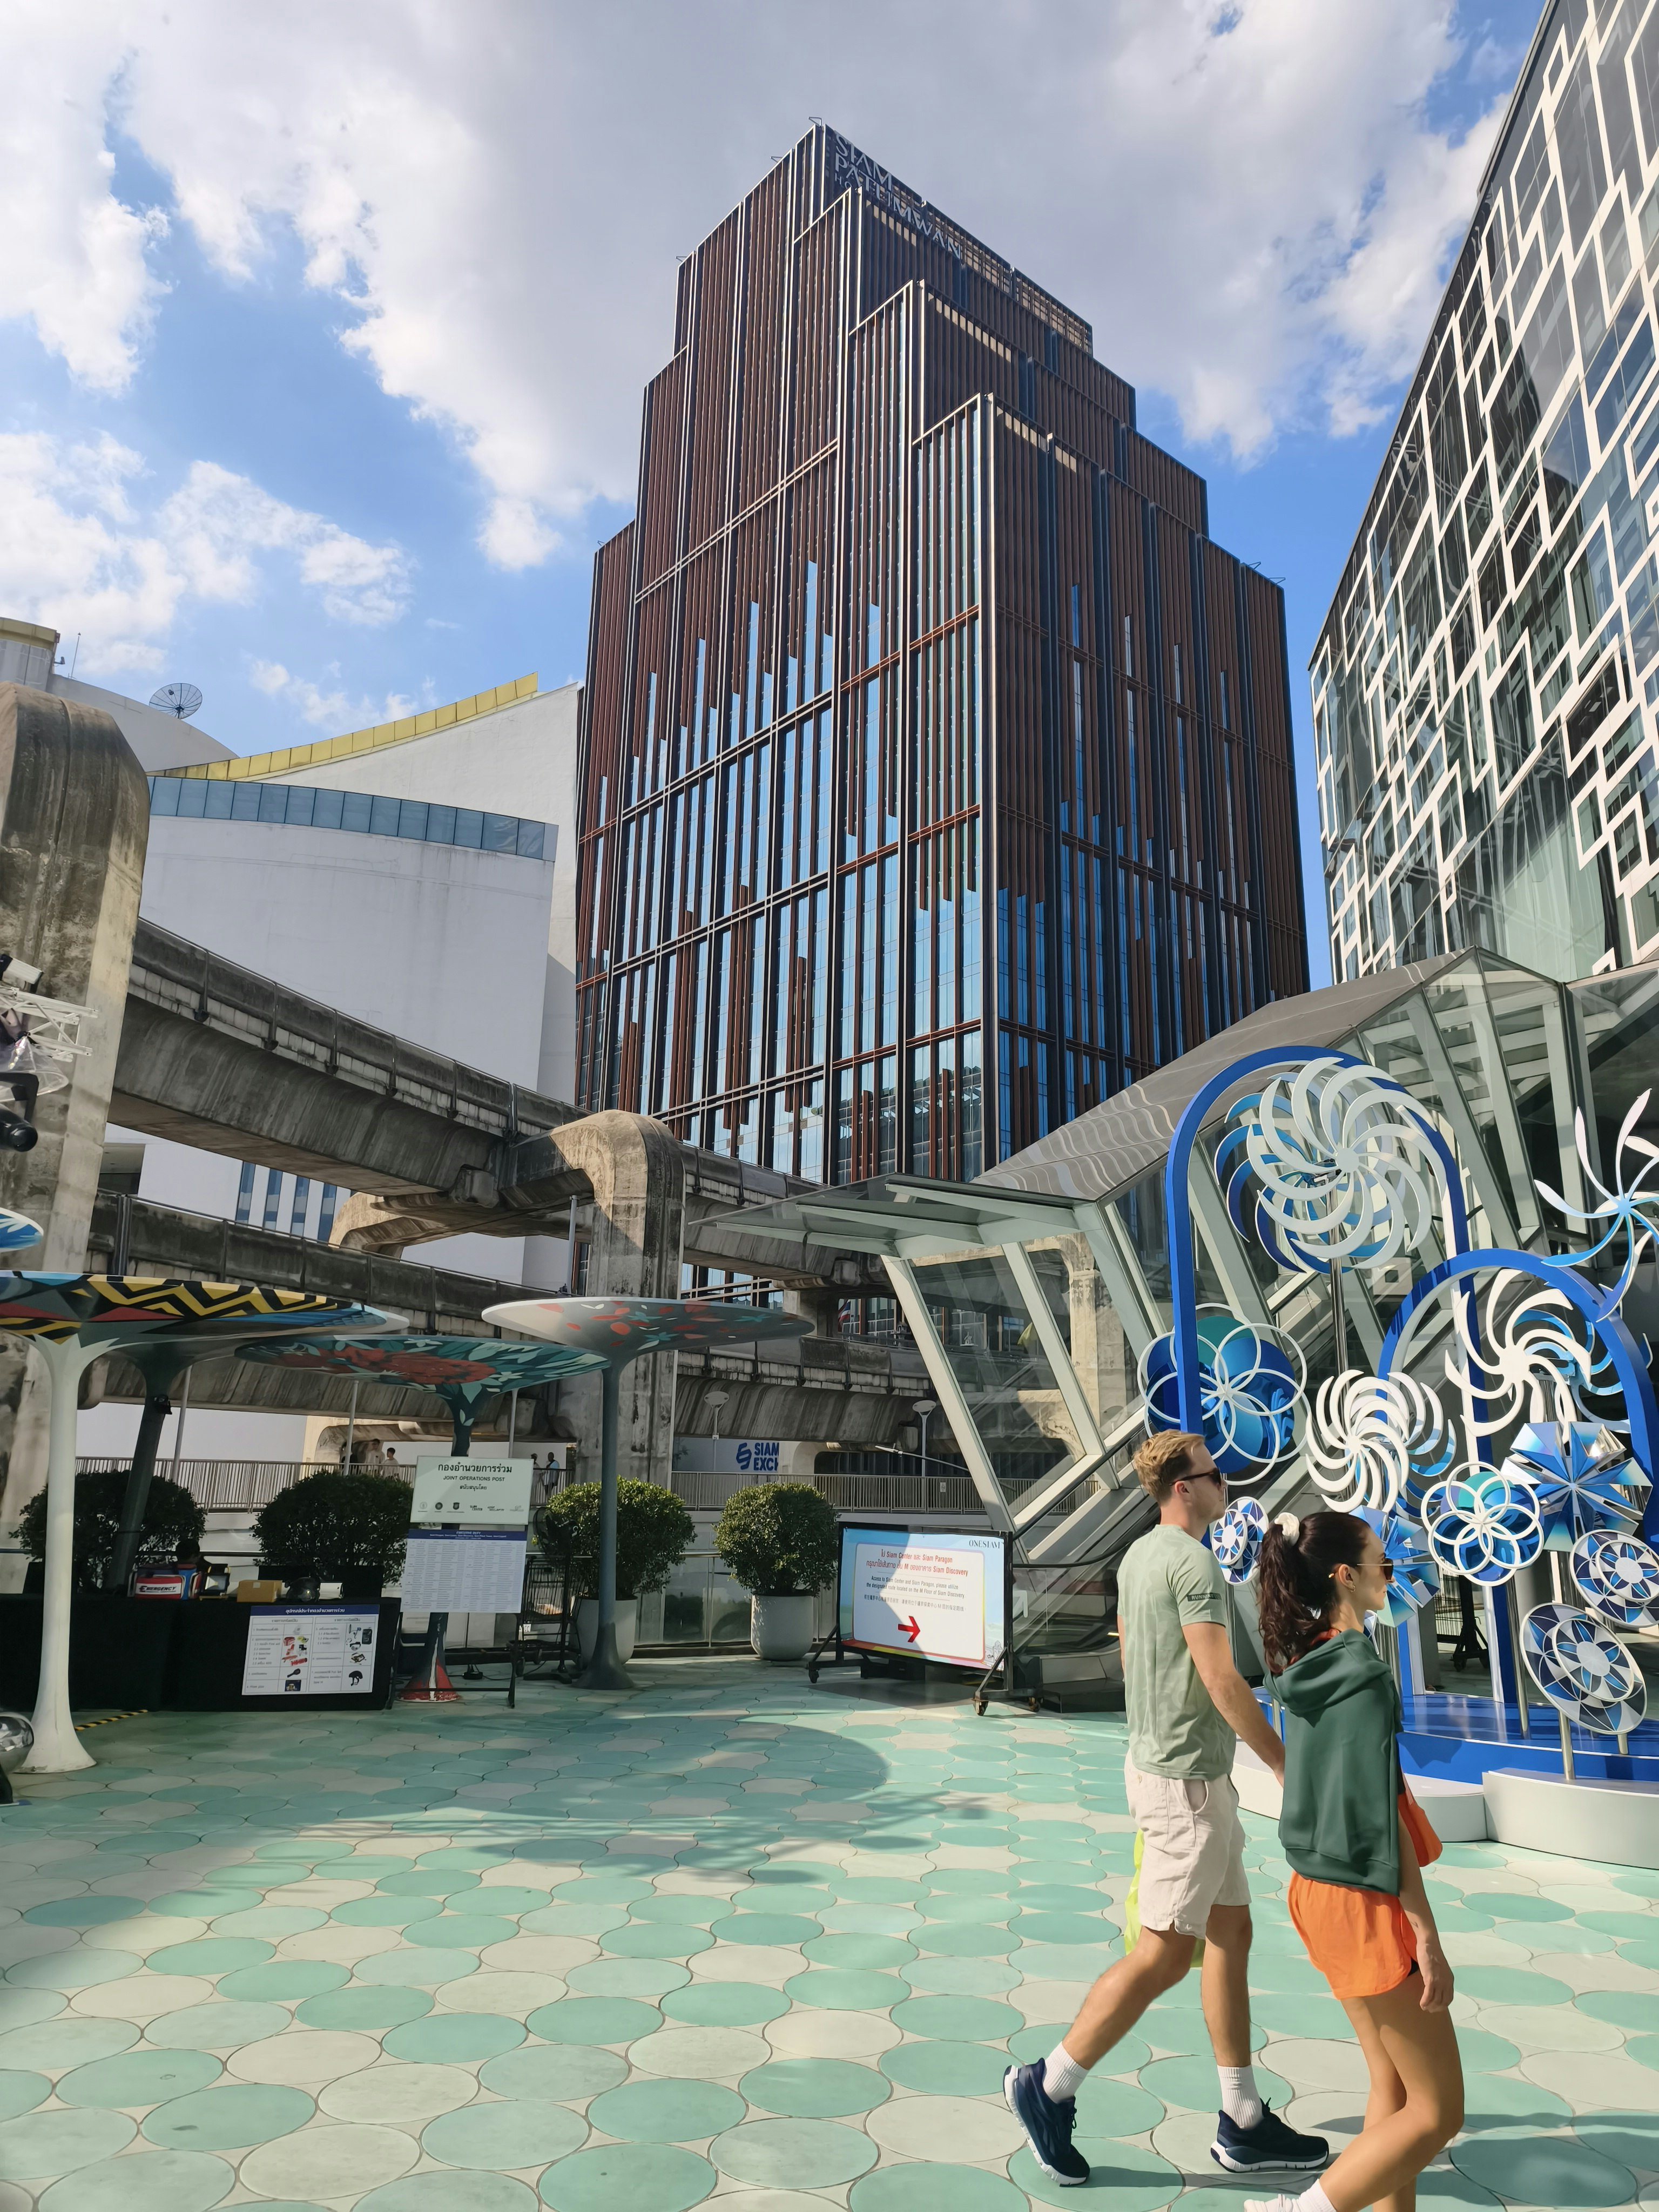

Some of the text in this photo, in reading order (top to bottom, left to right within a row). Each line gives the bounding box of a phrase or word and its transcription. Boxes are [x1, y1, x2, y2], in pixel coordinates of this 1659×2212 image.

[835, 133, 892, 192] SIAM
[835, 152, 961, 260] PATUMWAN
[754, 1442, 779, 1456] SIAM
[438, 1461, 512, 1473] กองอำนวยการร่วม
[968, 1540, 1001, 1549] ONESIAM
[881, 1549, 885, 1557] ไป
[935, 1555, 953, 1564] Paragon
[910, 1564, 932, 1573] ของอาคาร
[946, 1567, 968, 1577] Discovery
